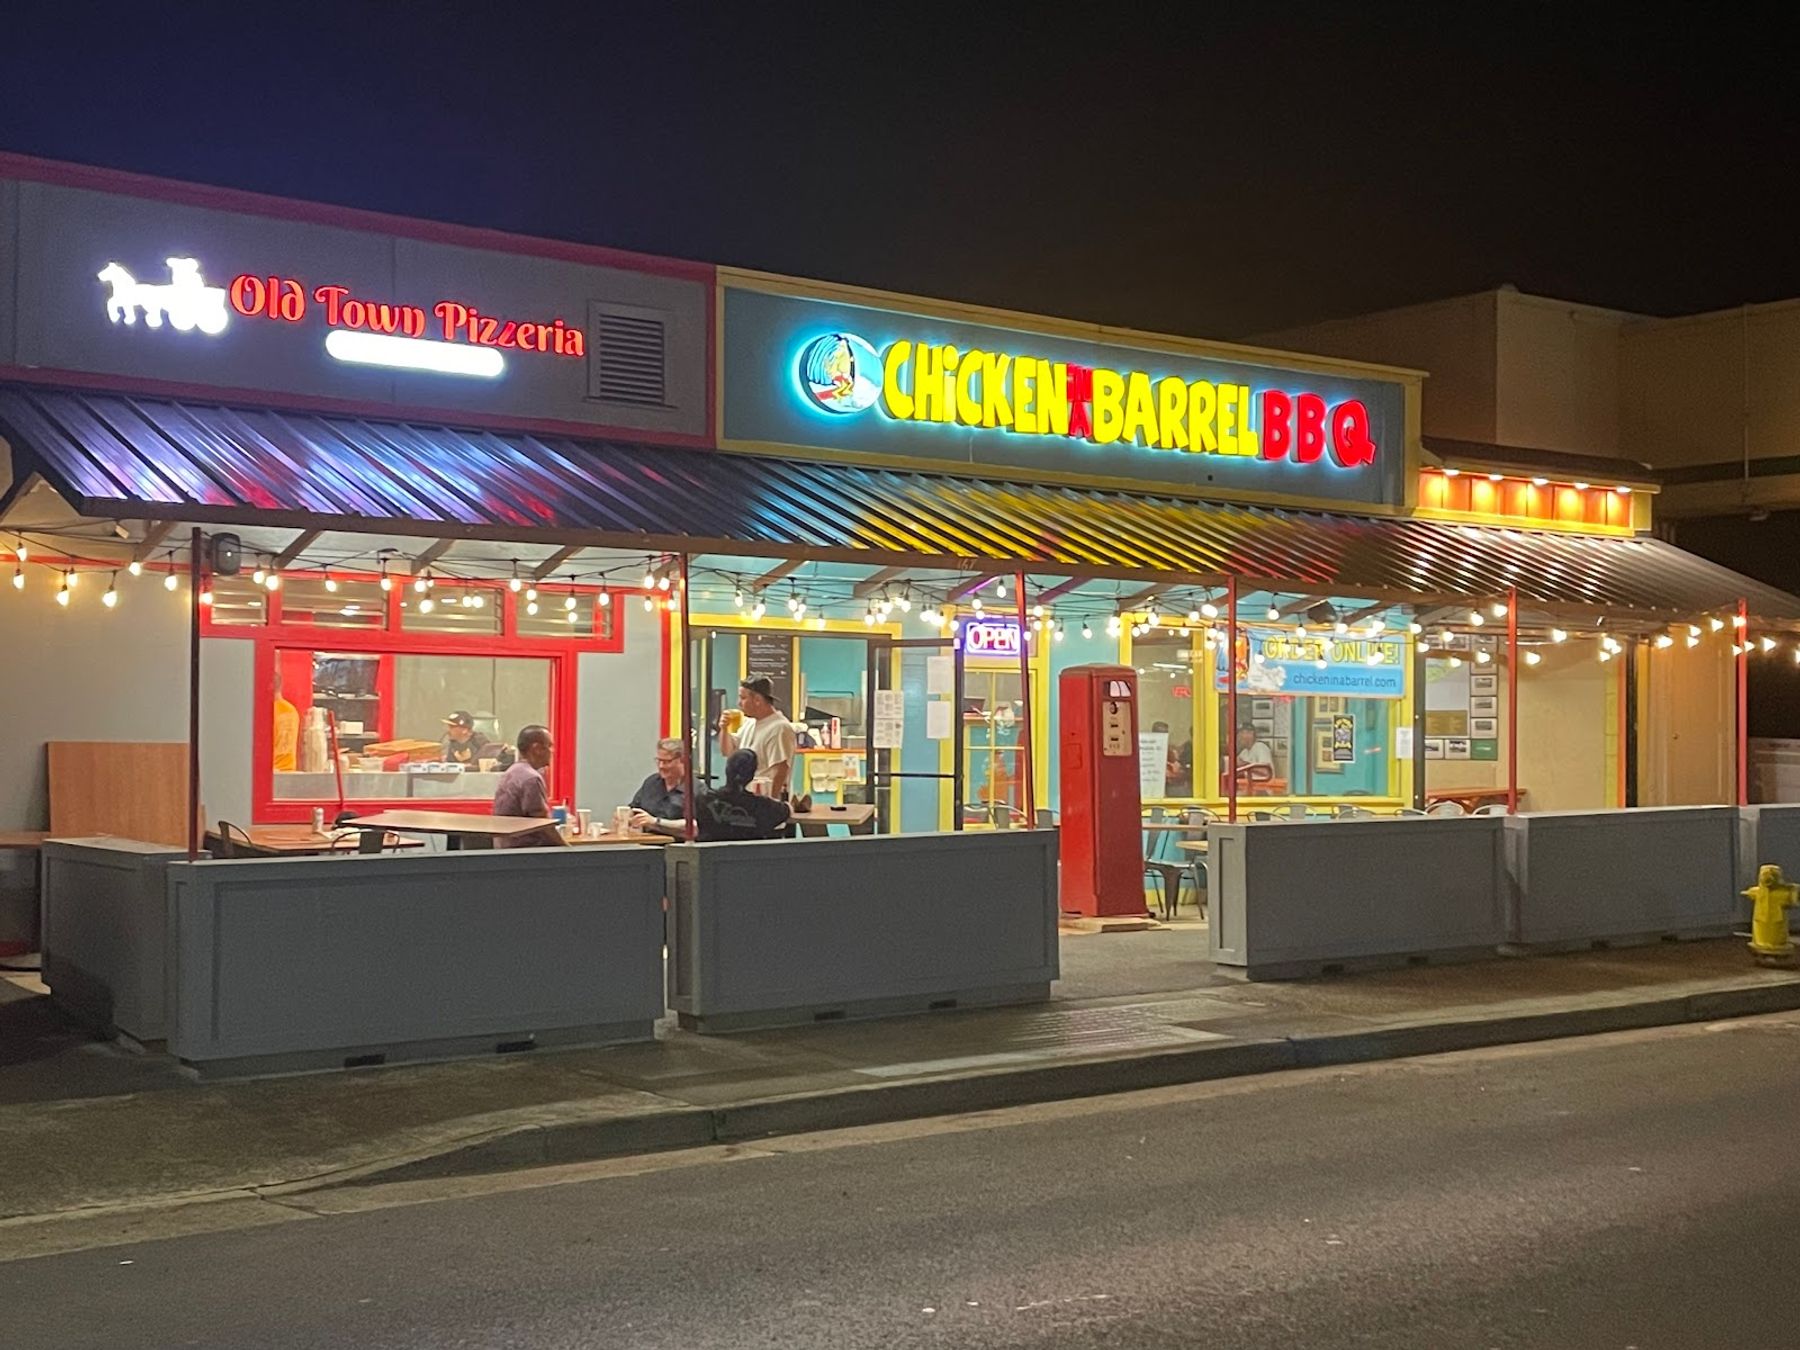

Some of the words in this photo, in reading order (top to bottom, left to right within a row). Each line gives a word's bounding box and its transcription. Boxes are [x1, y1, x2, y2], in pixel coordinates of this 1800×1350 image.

[230, 274, 306, 322] Old
[313, 285, 426, 338] Town
[434, 301, 585, 357] Pizzeria
[1069, 400, 1092, 437] A
[1092, 369, 1258, 456] BARREL
[970, 627, 1018, 650] OPEN
